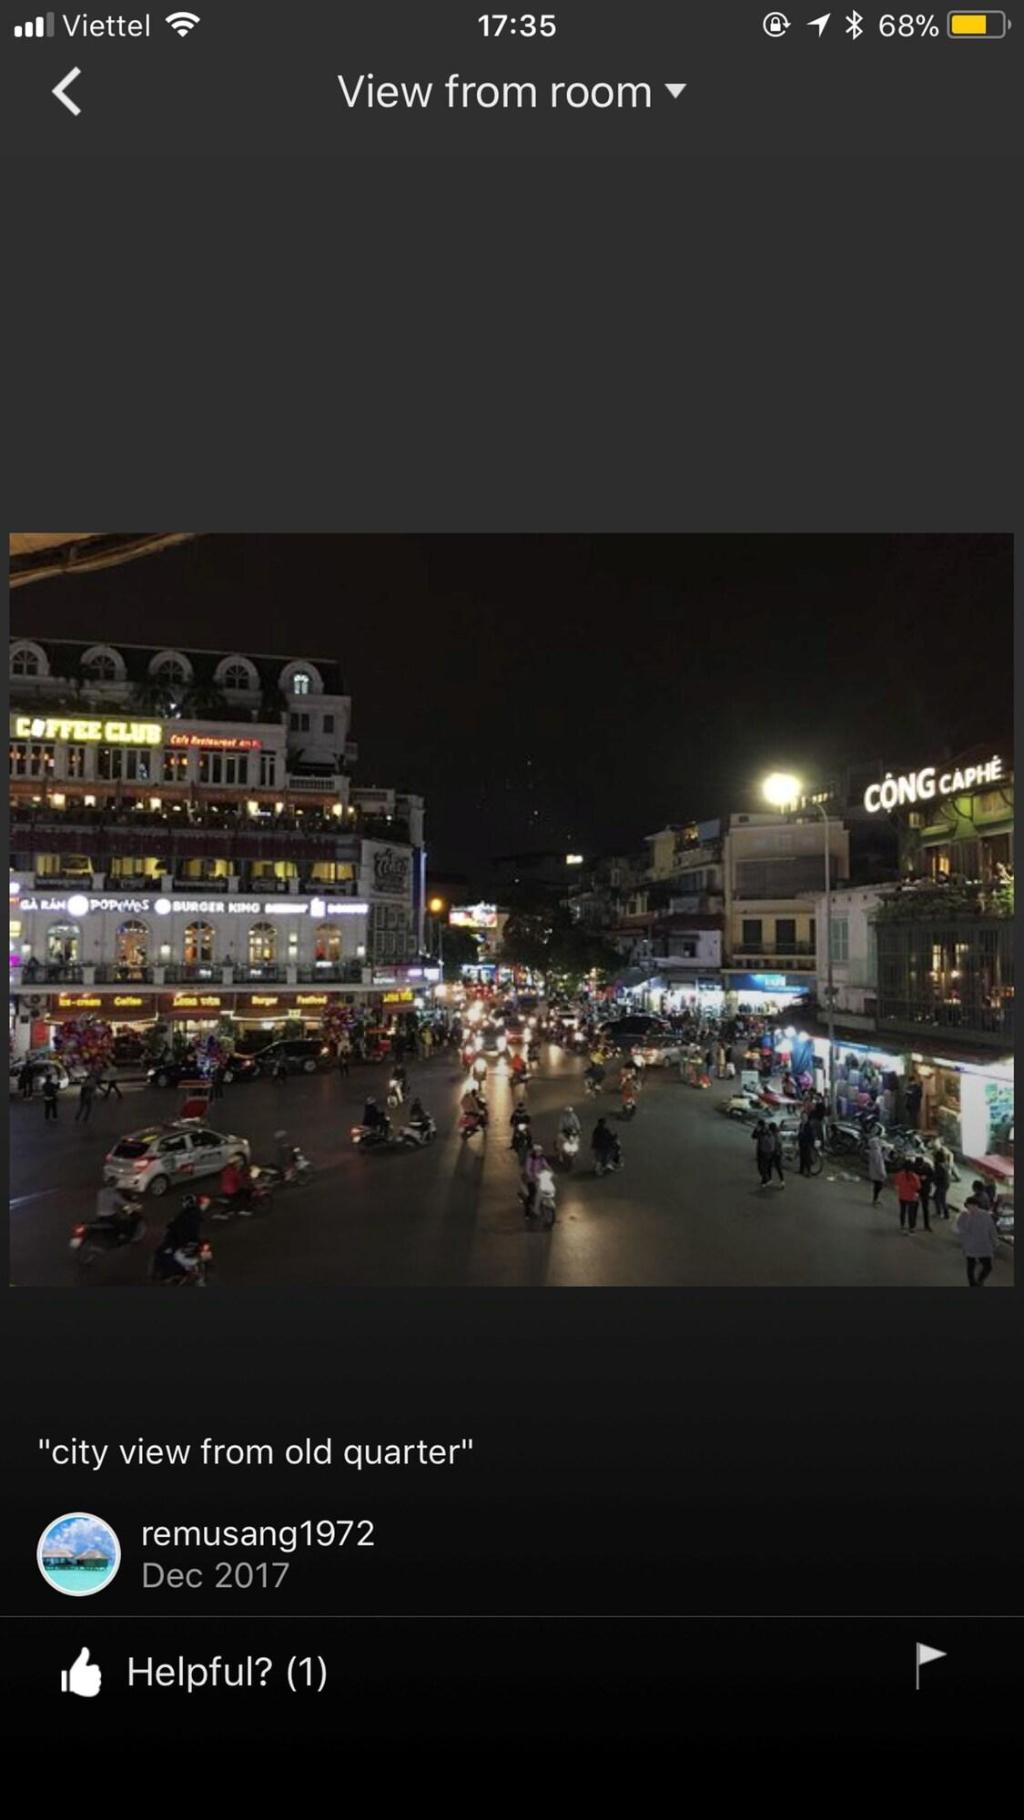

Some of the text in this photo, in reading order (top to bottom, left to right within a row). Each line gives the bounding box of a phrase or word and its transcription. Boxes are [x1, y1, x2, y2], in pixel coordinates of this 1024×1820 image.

[16, 717, 162, 744] COFFEE CLUB
[863, 767, 936, 813] CỘNG
[172, 900, 225, 914] BURGER
[228, 901, 261, 914] KING
